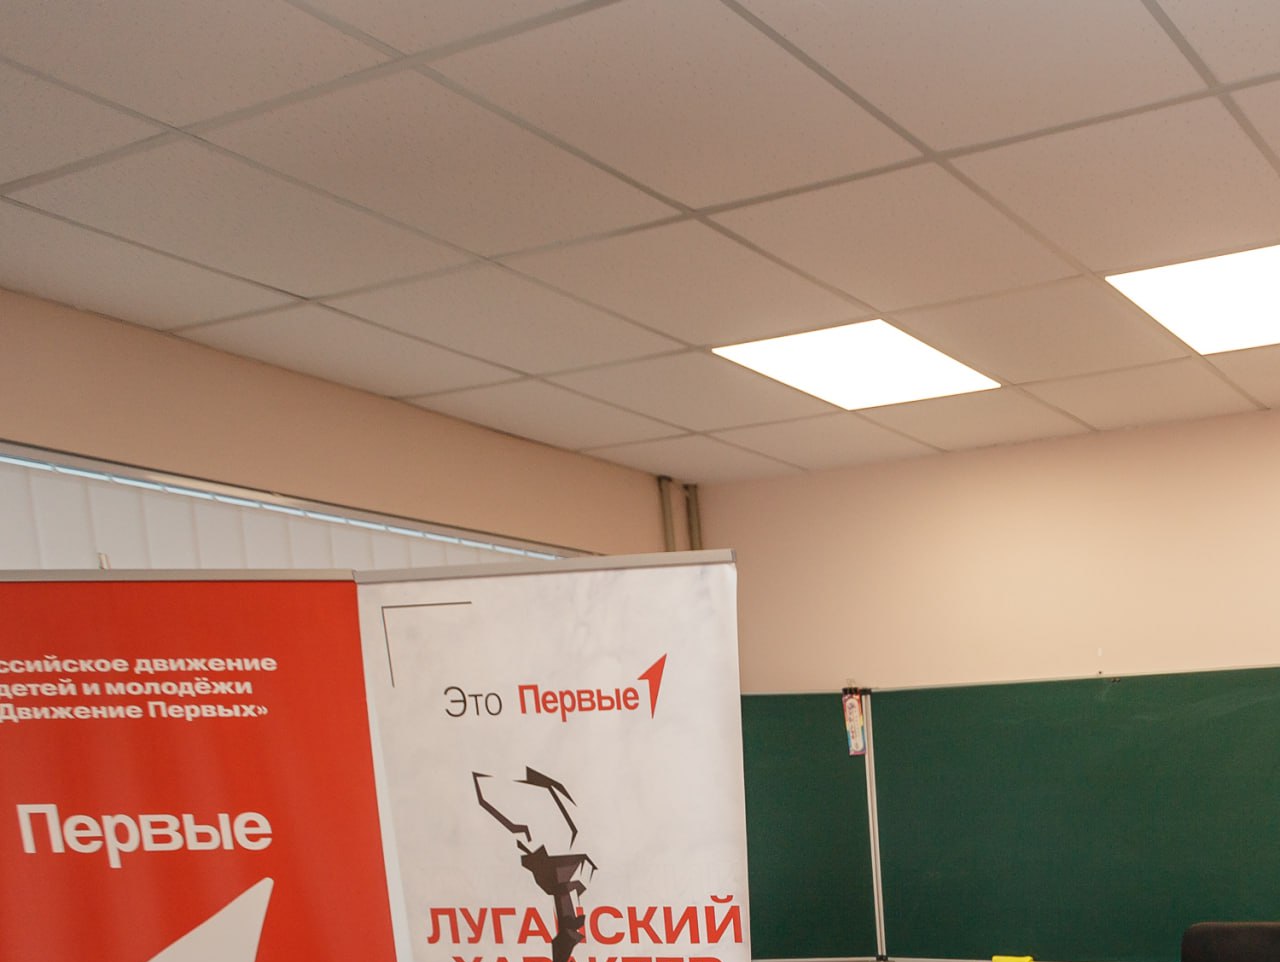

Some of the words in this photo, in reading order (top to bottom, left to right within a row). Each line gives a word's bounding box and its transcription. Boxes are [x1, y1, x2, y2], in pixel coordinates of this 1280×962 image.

[134, 657, 278, 675] движение
[83, 682, 100, 696] и
[105, 677, 253, 698] молодёжи
[147, 701, 269, 722] Первых»
[443, 686, 503, 718] Это
[518, 684, 640, 722] Первые
[16, 803, 273, 868] Первые
[427, 895, 744, 945] ЛУГАСКИЙ
